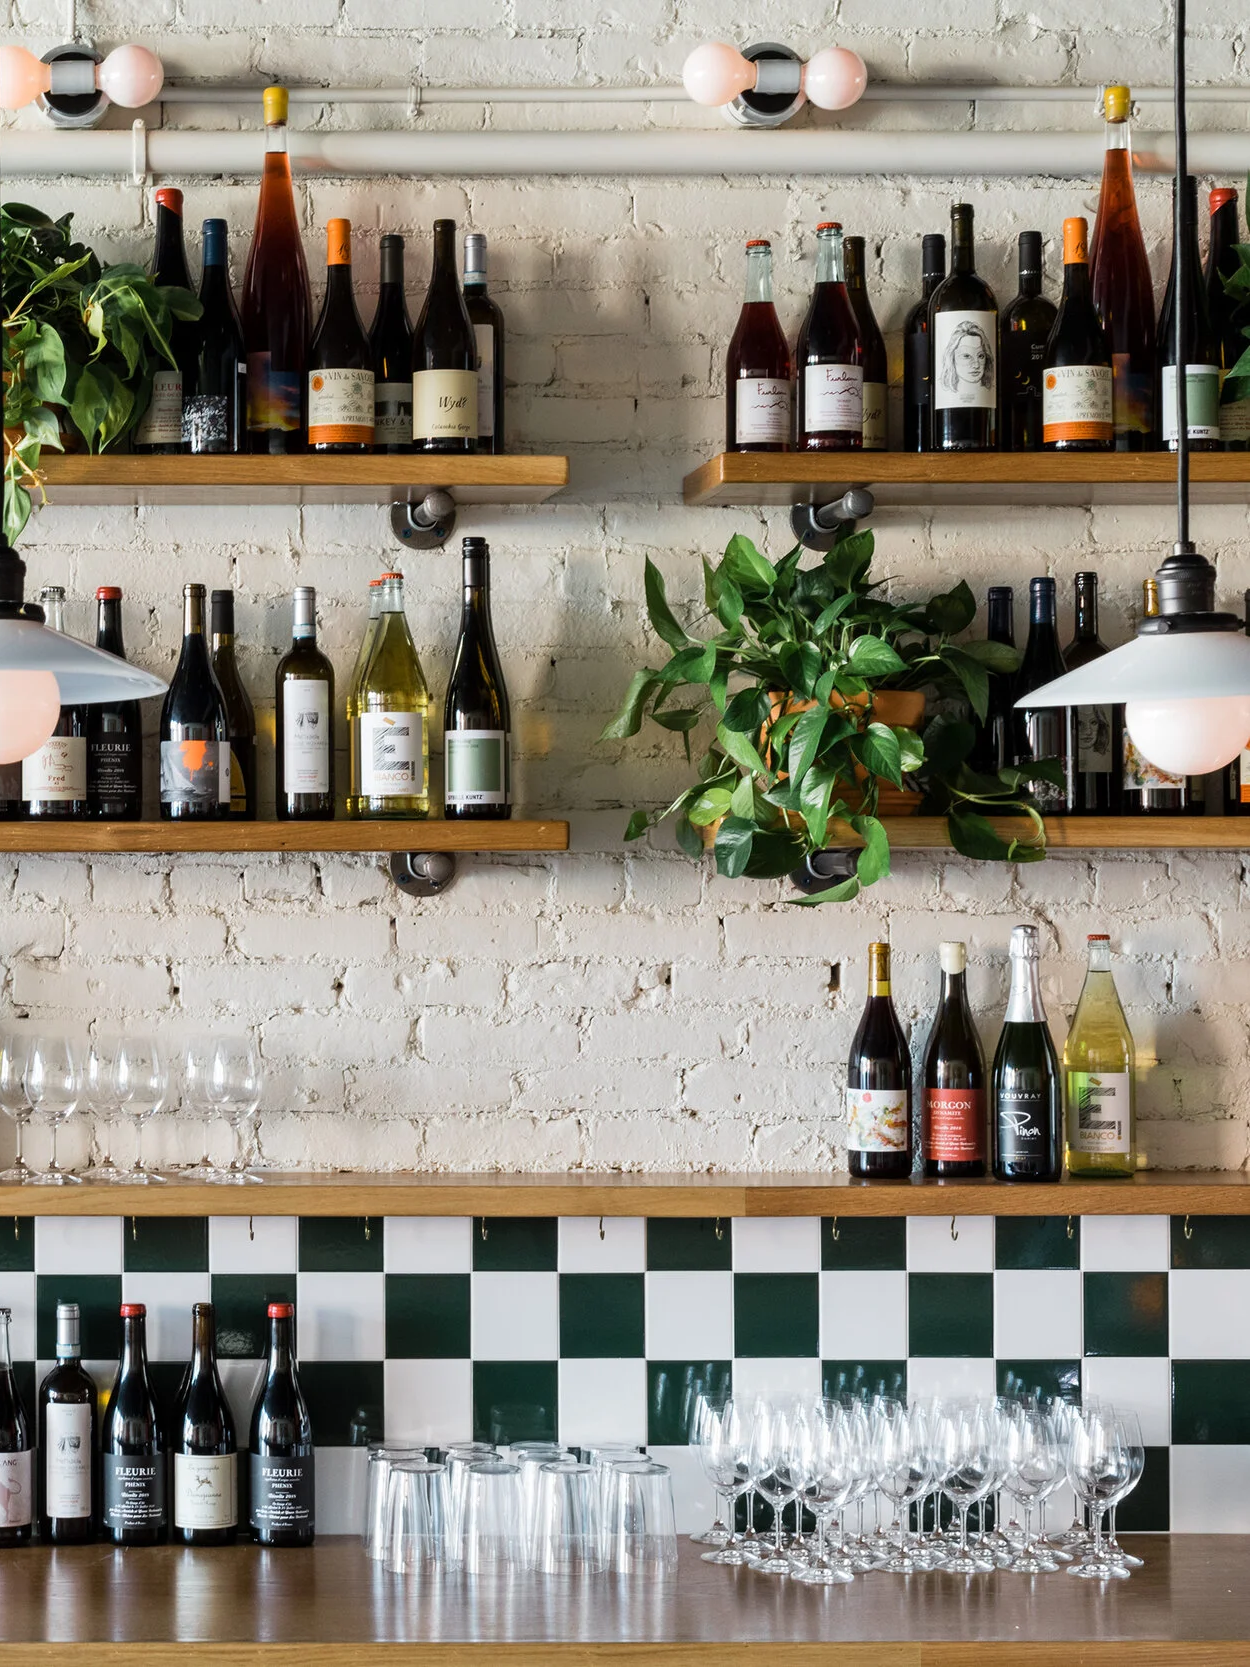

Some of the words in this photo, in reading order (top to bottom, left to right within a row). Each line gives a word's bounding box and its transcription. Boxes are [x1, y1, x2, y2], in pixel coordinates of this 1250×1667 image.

[91, 743, 131, 751] FLEURIE
[927, 1101, 971, 1110] MORGON
[1000, 1111, 1041, 1136] Pinon
[1080, 1131, 1115, 1141] BIANCO
[115, 1467, 156, 1476] FLEURIE
[262, 1468, 303, 1477] FLEURIE
